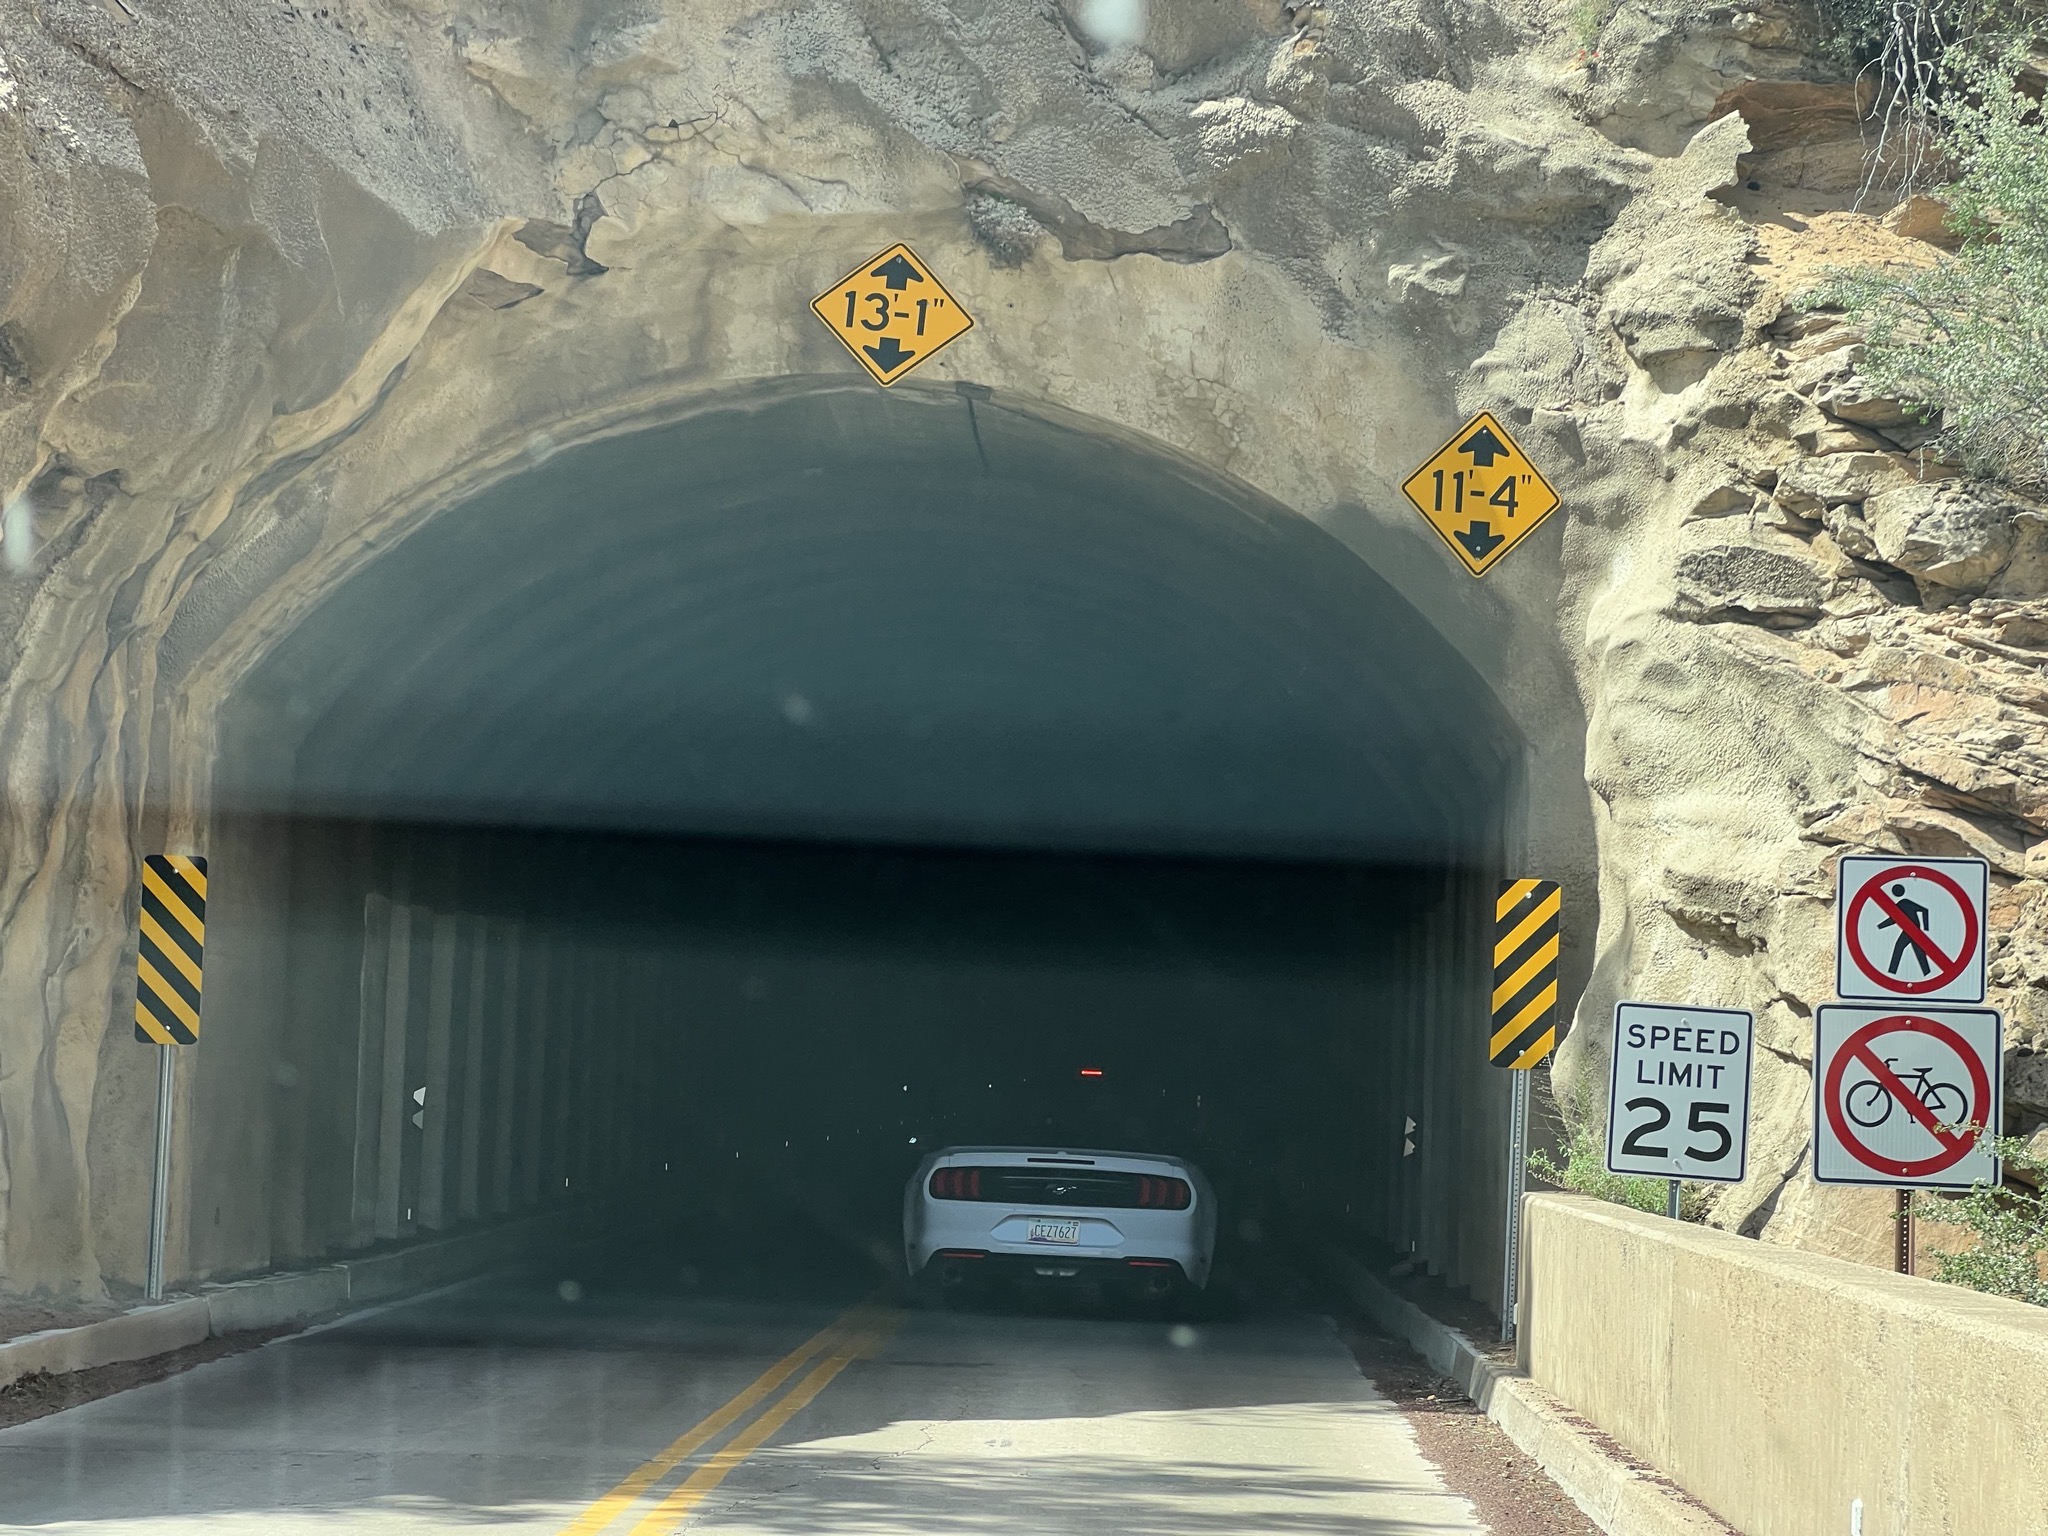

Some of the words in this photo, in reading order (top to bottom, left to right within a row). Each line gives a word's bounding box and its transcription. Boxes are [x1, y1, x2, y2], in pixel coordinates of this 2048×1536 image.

[845, 290, 945, 336] 13'-1"
[1432, 469, 1532, 518] 11'-4"
[1626, 1023, 1740, 1055] SPEED
[1636, 1059, 1726, 1090] LIMIT
[1621, 1096, 1732, 1162] 25
[1034, 1224, 1077, 1239] CEZ7627
